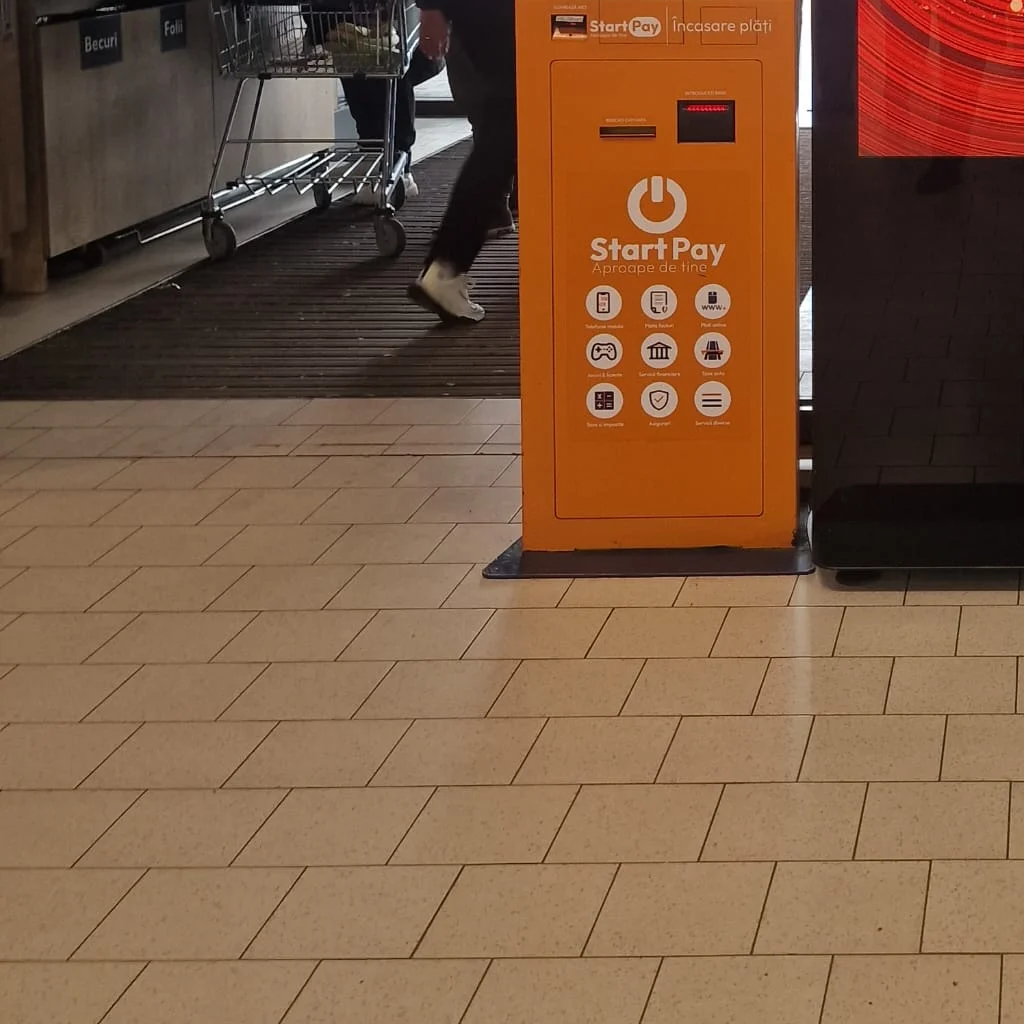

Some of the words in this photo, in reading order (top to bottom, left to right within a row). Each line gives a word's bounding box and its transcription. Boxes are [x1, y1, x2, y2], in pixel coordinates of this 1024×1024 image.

[164, 20, 183, 36] Folii
[671, 17, 736, 32] Încasare
[84, 32, 118, 52] Becuri
[590, 237, 668, 261] Start
[672, 237, 726, 266] Pay
[592, 262, 654, 276] Aproape
[659, 262, 677, 273] de
[681, 262, 707, 273] tine
